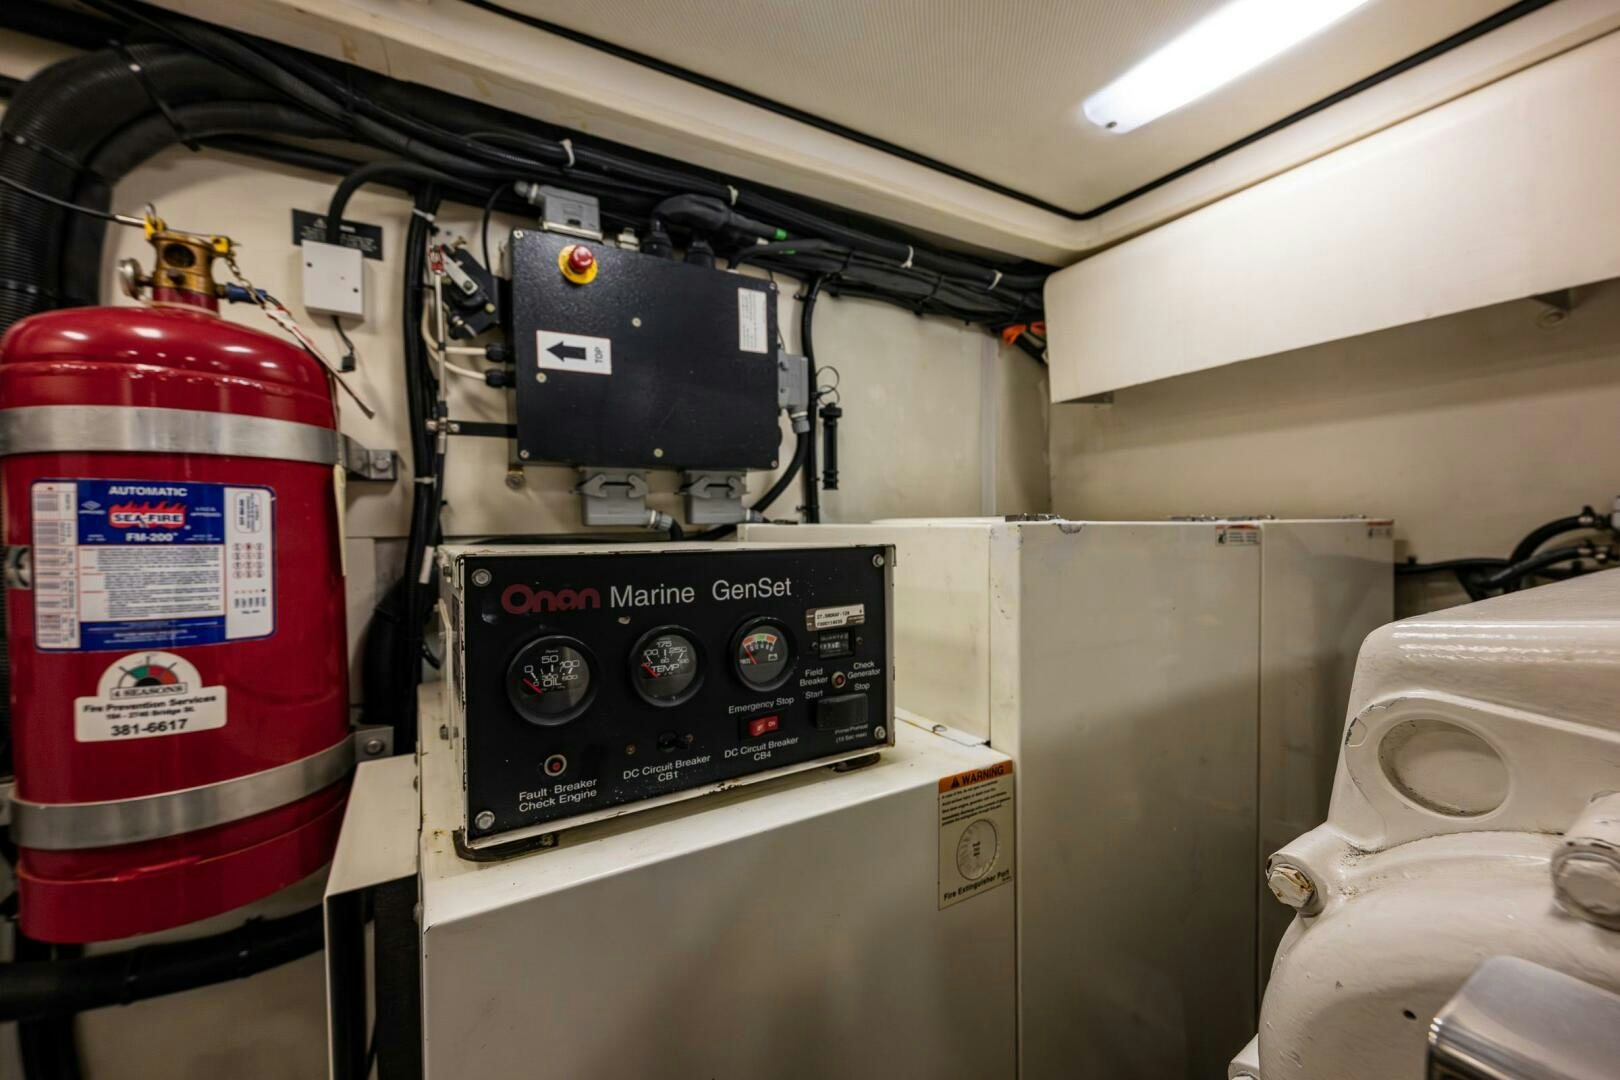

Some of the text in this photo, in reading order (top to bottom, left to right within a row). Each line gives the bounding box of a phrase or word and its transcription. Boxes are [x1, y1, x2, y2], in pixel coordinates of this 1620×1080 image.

[594, 346, 603, 364] TOP
[108, 486, 188, 497] AUTOMATIC
[501, 577, 792, 615] Onan Marine GenSet
[541, 655, 559, 664] 50
[853, 660, 875, 670] Check
[651, 663, 680, 673] TEMP
[804, 667, 823, 677] Field
[847, 668, 881, 680] Generator
[543, 678, 562, 687] OIL
[800, 676, 829, 687] Breaker
[854, 682, 871, 691] Stop
[805, 690, 823, 700] Start
[105, 701, 167, 711] Prevention
[169, 694, 217, 706] Services
[728, 696, 795, 714] Emergency Stop
[724, 736, 799, 759] DC Circuit Breaker
[753, 750, 772, 761] CB4
[623, 754, 711, 780] DC Circuit Breaker
[962, 765, 1004, 785] WARNING
[519, 778, 598, 801] Fault Breaker
[519, 789, 597, 812] Check Engine
